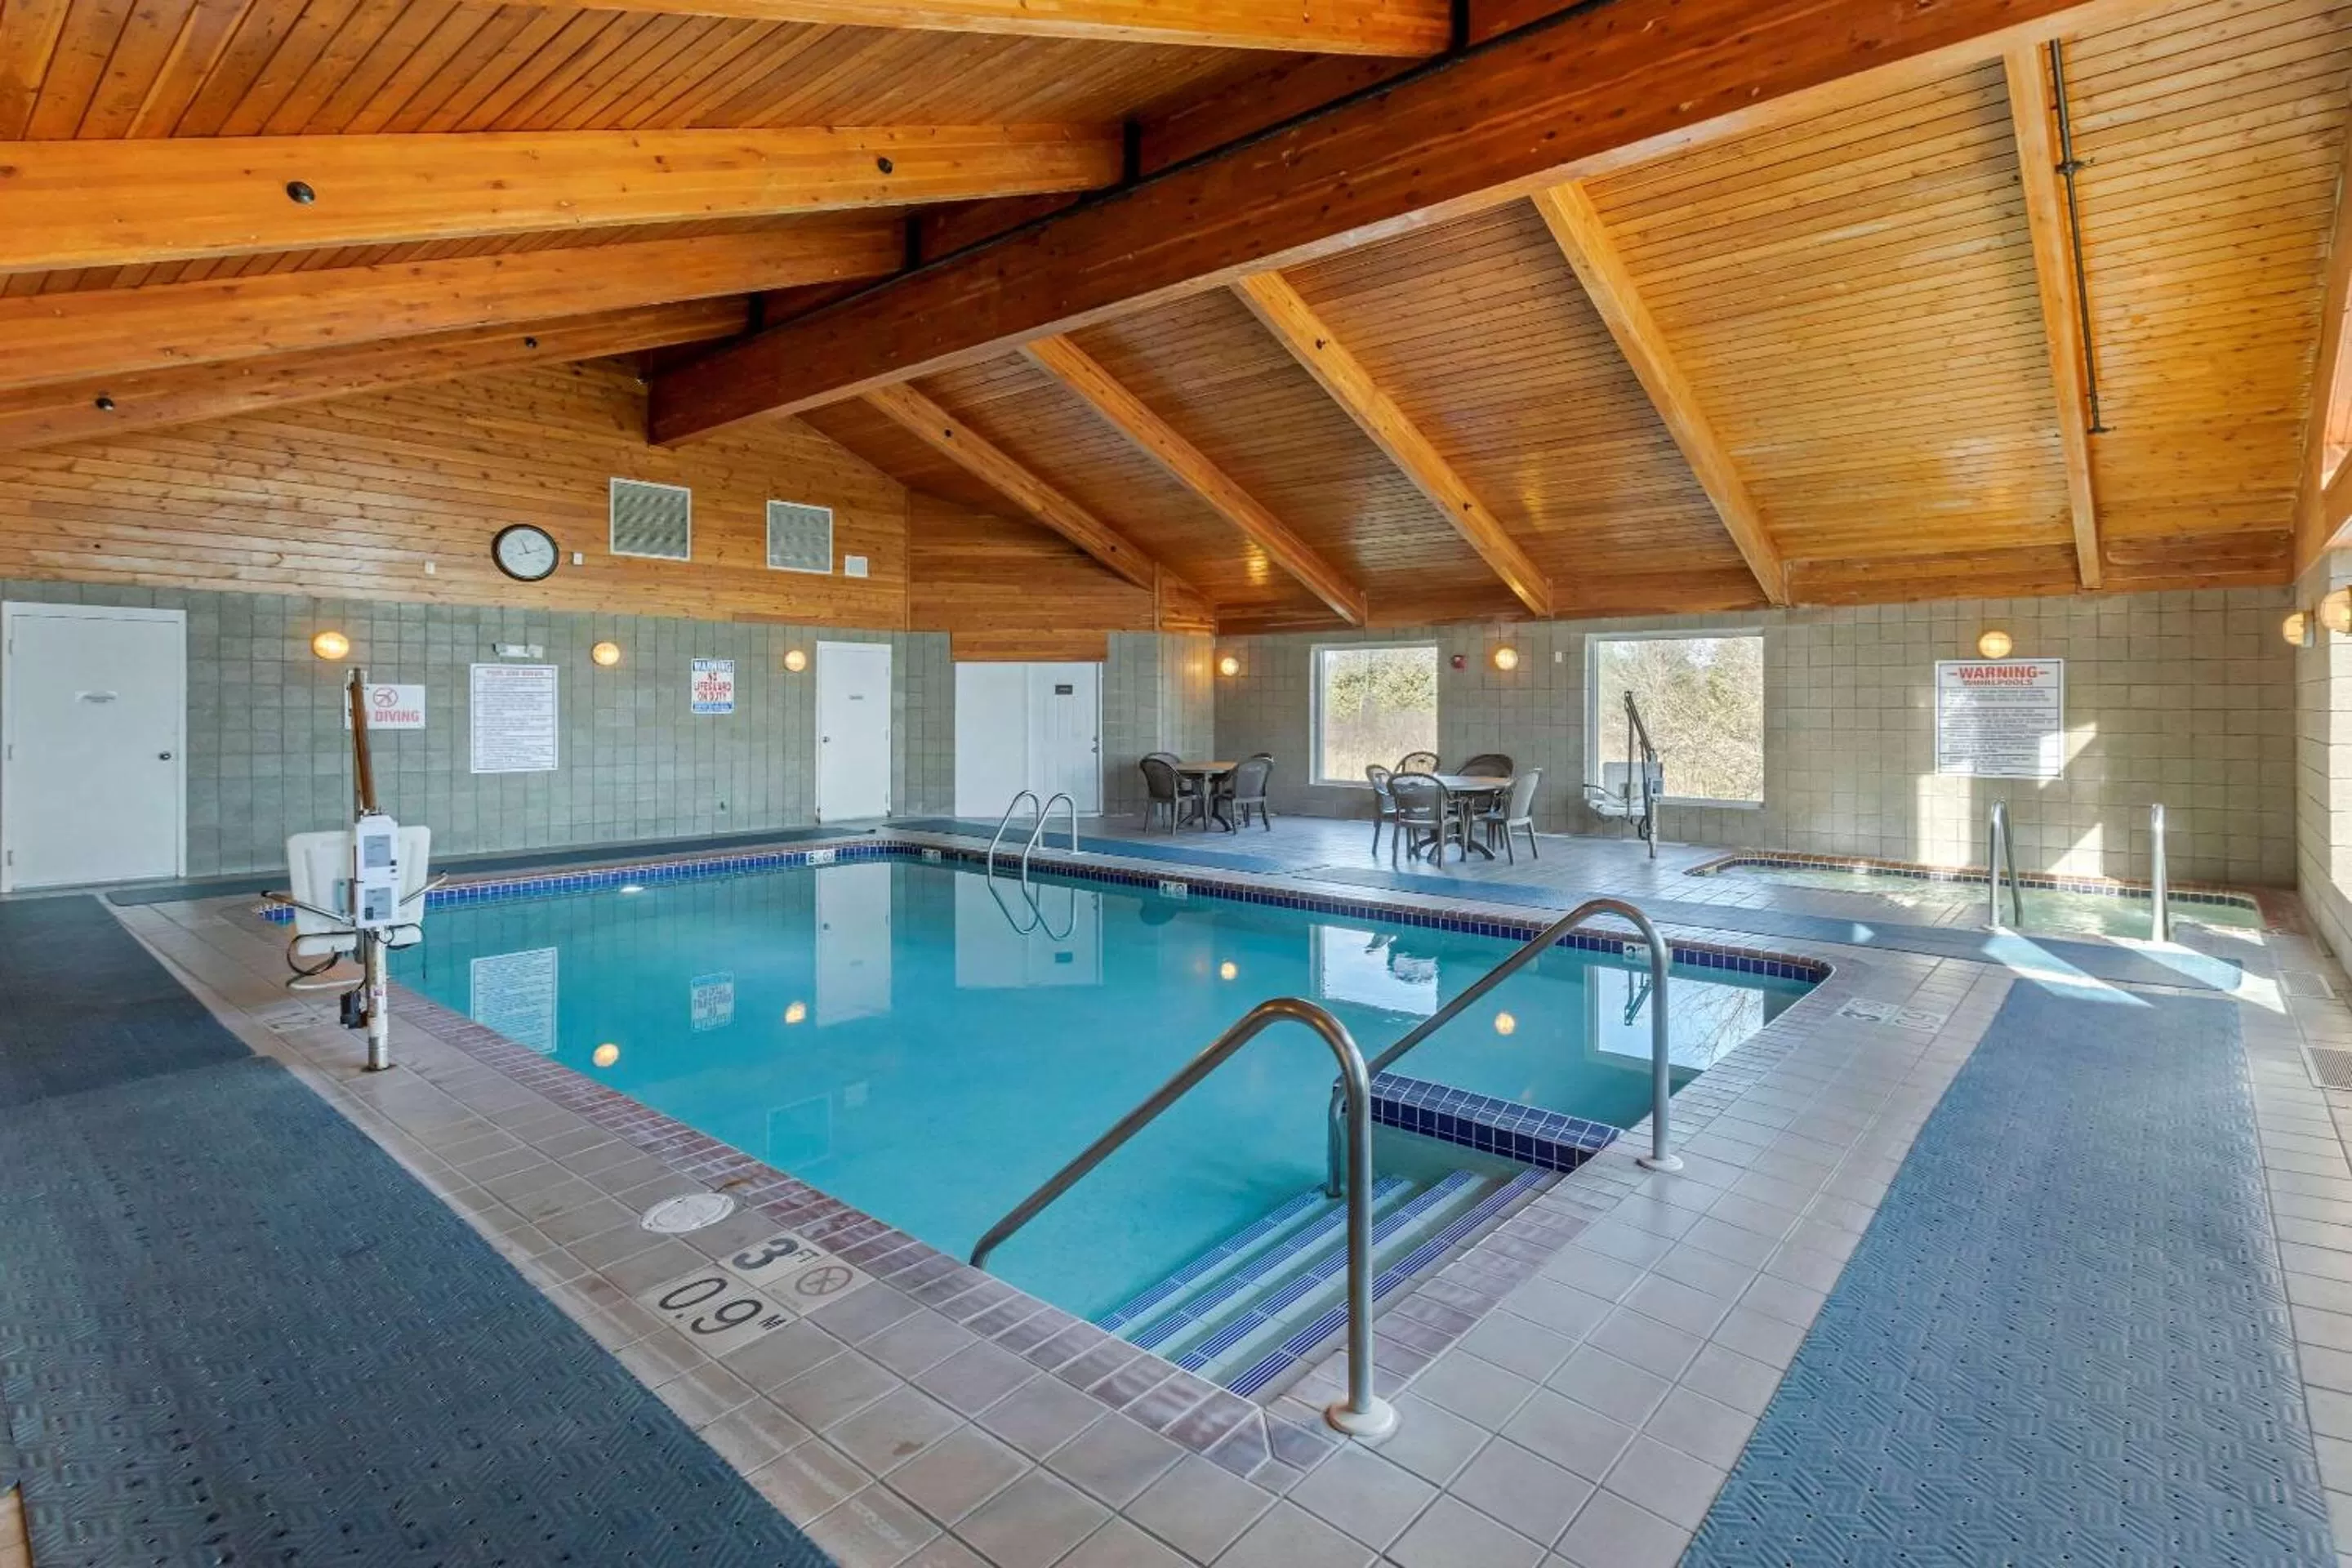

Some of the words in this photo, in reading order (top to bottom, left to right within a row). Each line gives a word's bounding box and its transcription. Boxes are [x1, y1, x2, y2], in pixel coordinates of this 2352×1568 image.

[1958, 666, 2038, 679] WARNING
[375, 710, 420, 722] DIVING
[733, 1238, 799, 1270] 3
[658, 1277, 763, 1334] 0.9
